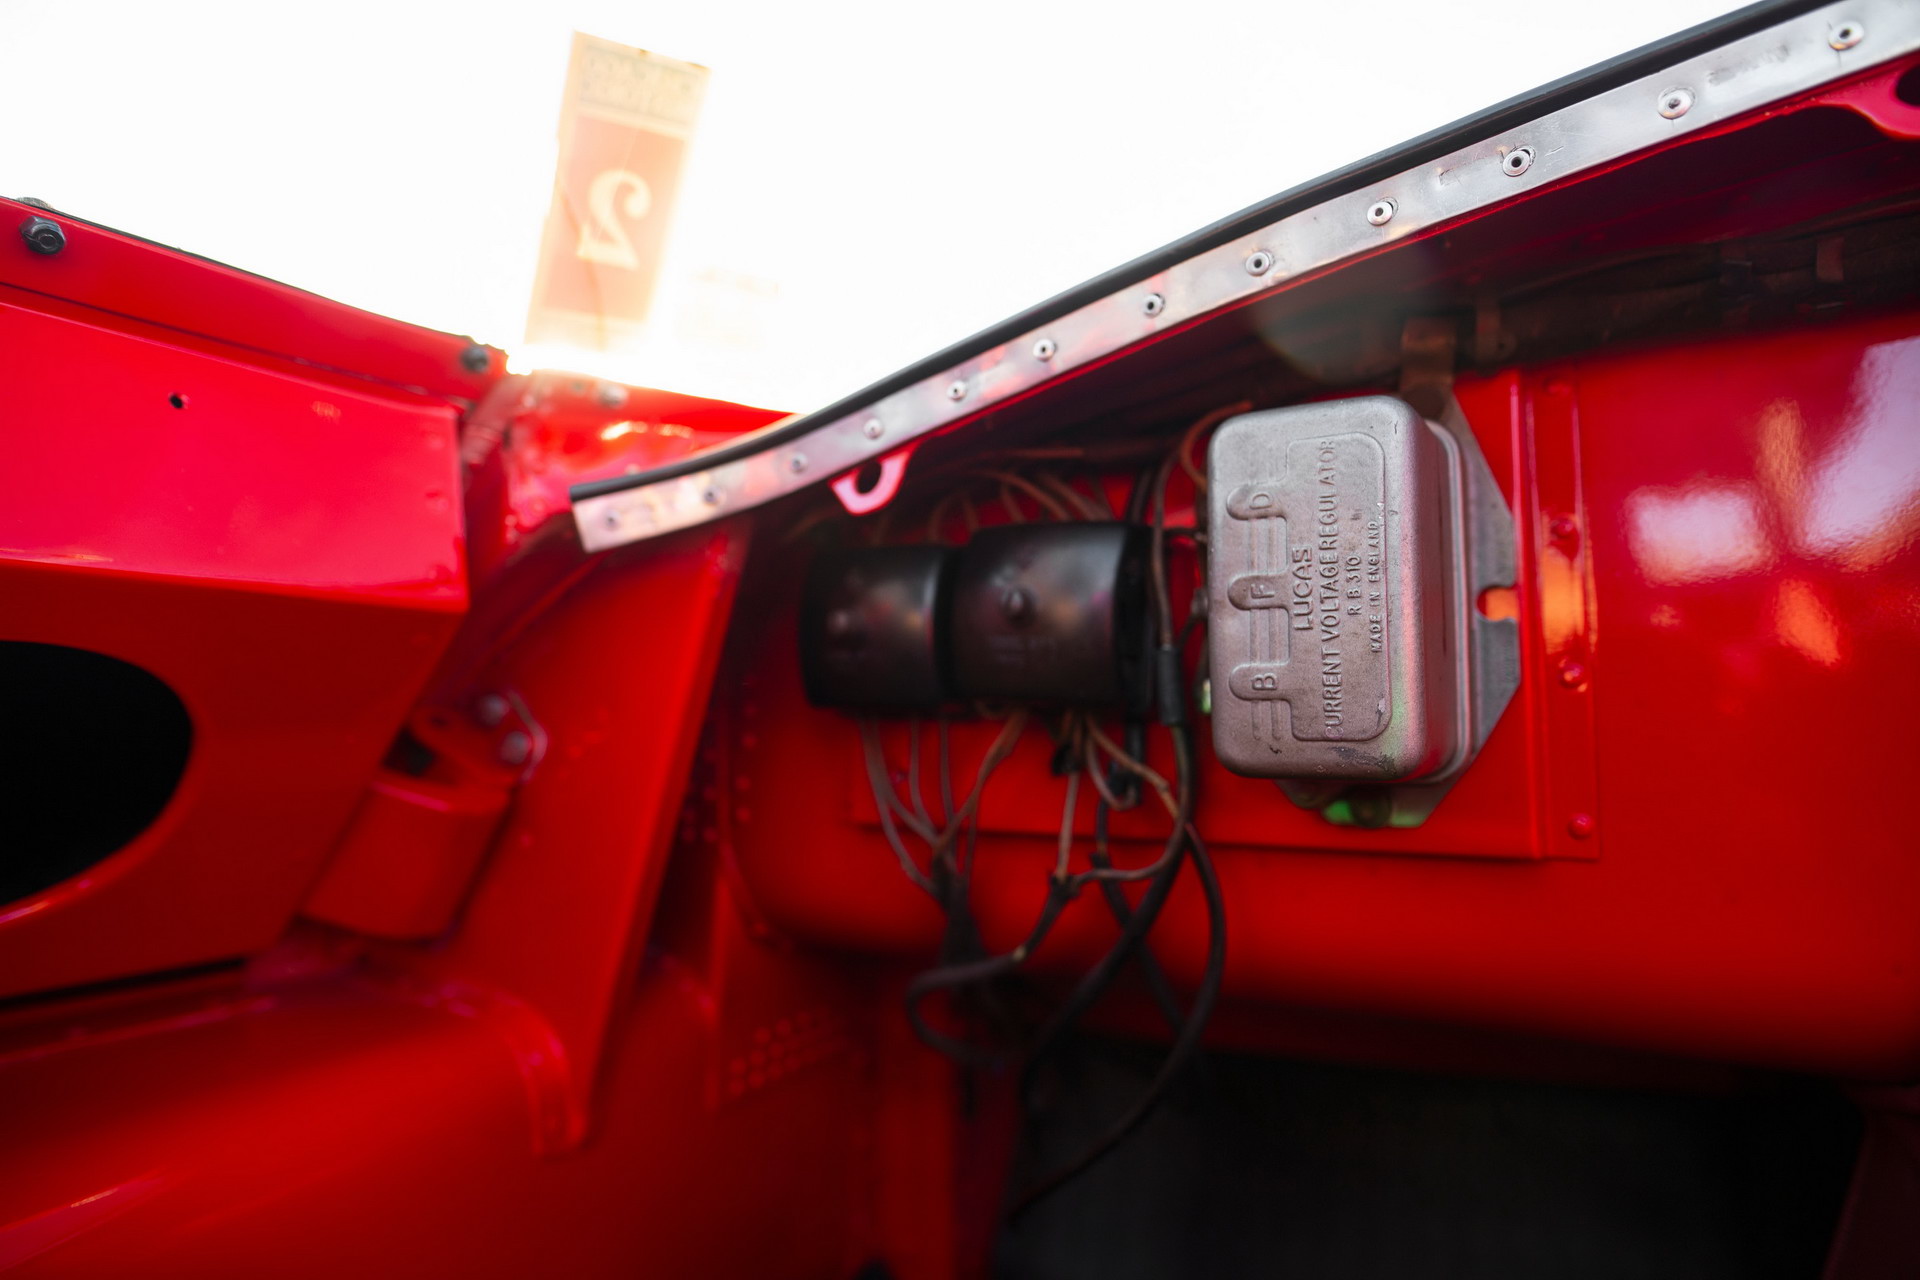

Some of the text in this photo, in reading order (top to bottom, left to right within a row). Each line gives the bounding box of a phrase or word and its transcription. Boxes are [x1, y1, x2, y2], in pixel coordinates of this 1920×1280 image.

[1250, 491, 1275, 512] D
[1250, 582, 1276, 600] F
[1291, 545, 1314, 632] LUCAS
[1319, 551, 1341, 641] VOLTAGE
[1367, 520, 1383, 653] MADE IN ENGLAND
[1251, 672, 1278, 692] B
[1321, 645, 1344, 738] CURRENT
